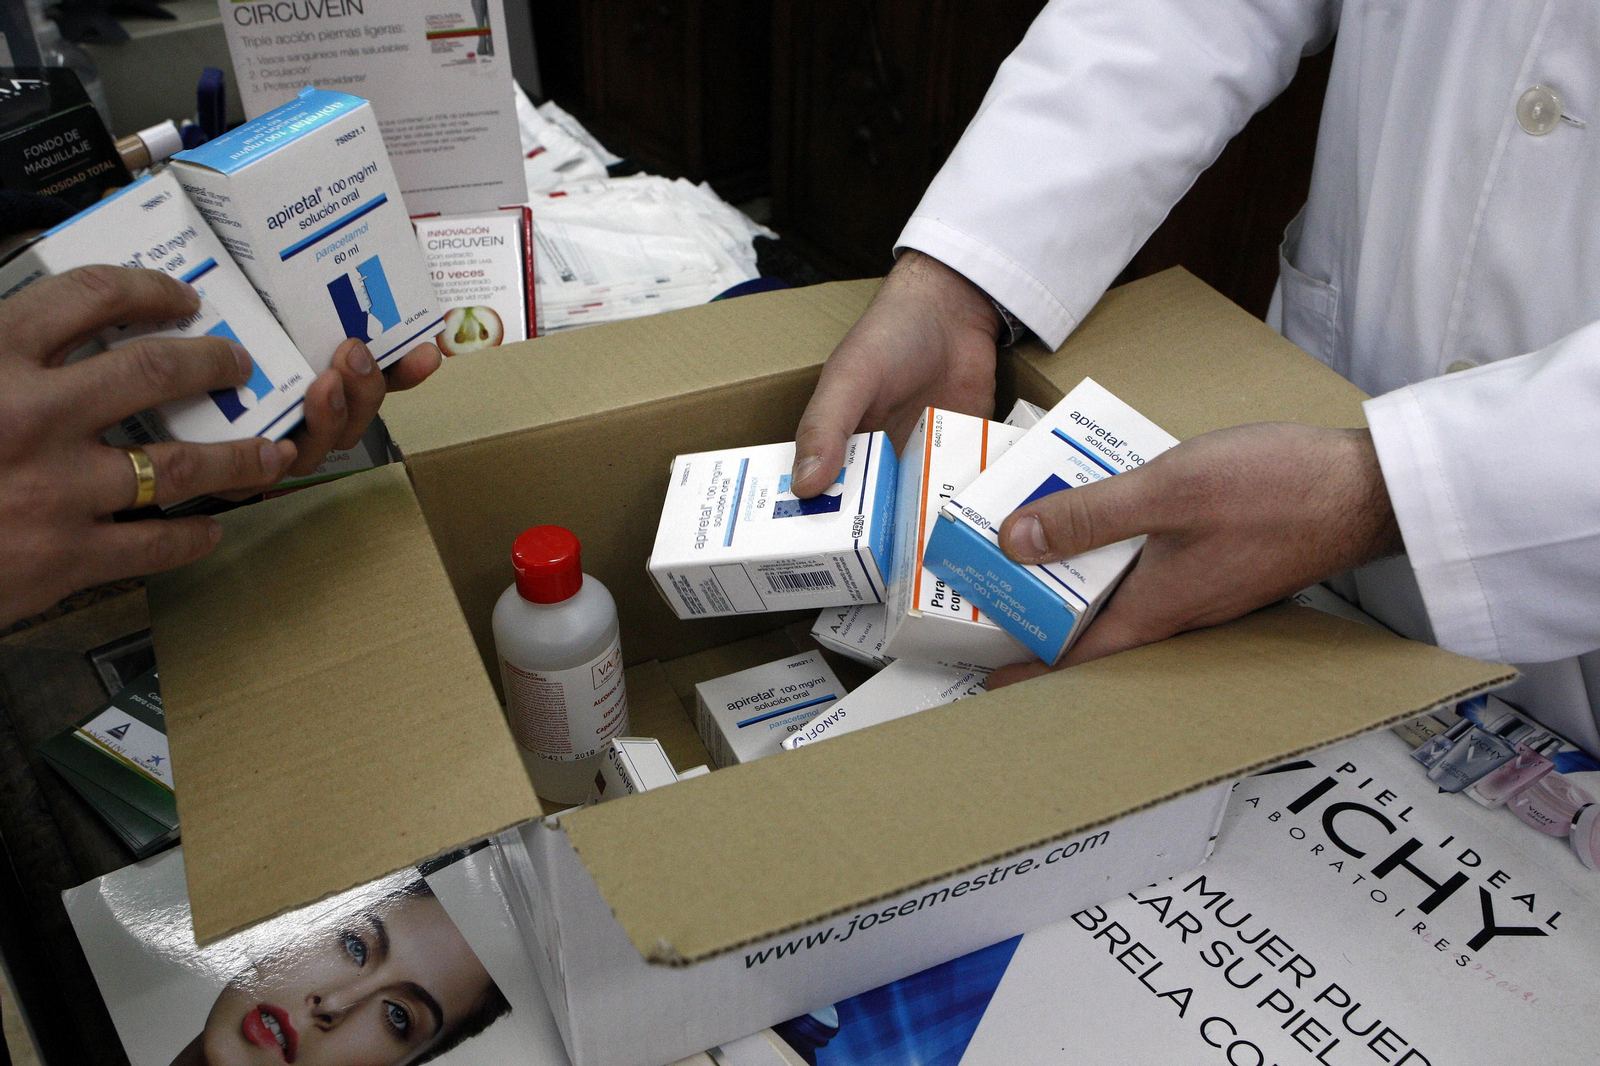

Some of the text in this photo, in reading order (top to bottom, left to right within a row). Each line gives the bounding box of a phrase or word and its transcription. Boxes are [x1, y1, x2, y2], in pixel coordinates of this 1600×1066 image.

[234, 0, 364, 27] CIRCUVEIN
[242, 34, 272, 49] Triple
[275, 29, 316, 45] acción
[318, 26, 361, 42] piernas
[23, 128, 81, 160] FONDO DE
[24, 139, 93, 176] MAQUILLAJE
[86, 159, 116, 179] TOTAL
[326, 180, 347, 198] 100
[347, 161, 378, 184] mg/ml
[298, 189, 361, 230] solución oral
[314, 222, 370, 263] paracetamol
[426, 226, 490, 238] INNOVACIÓN
[426, 235, 505, 251] CIRCUVEIN
[333, 245, 360, 266] 60 ml
[426, 250, 474, 261] Con extracto
[427, 261, 438, 269] de
[466, 258, 478, 266] de
[430, 268, 485, 281] 10 veces
[445, 278, 492, 289] concentrado
[454, 294, 464, 302] de
[491, 284, 507, 293] que
[1084, 433, 1125, 466] solución
[1126, 449, 1146, 467] 100
[705, 485, 718, 502] 100
[712, 459, 724, 487] mg/ml
[1075, 472, 1089, 485] 60
[713, 477, 732, 528] solución oral
[743, 476, 759, 523] paracetamol
[756, 496, 767, 510] 60
[942, 557, 973, 585] mg/ml
[986, 568, 1013, 594] 60 ml
[1069, 567, 1087, 585] ORAL
[930, 576, 945, 609] Para
[965, 565, 1027, 614] solución oral
[972, 583, 991, 600] 100
[830, 604, 853, 634] A.A.
[865, 622, 874, 636] oral
[787, 658, 815, 669] 750521.1
[593, 686, 618, 707] ALCOHOL
[779, 683, 797, 695] 100
[798, 675, 827, 693] mg/ml
[129, 694, 148, 706] para
[753, 689, 811, 713] solución oral
[603, 706, 615, 719] USO
[769, 708, 820, 731] paracetamol
[786, 723, 800, 734] 60
[805, 707, 847, 742] SANOFI
[574, 749, 596, 760] 2018
[1470, 733, 1507, 760] VICHY
[614, 759, 634, 795] SANOFI
[1335, 761, 1414, 824] PIEL
[1528, 805, 1557, 825] VICHY
[1438, 835, 1563, 931] IDEAL
[744, 829, 1111, 970] www.josemestre.com
[1182, 874, 1316, 989] MUJER
[1127, 892, 1341, 1066] AR SU PIEL
